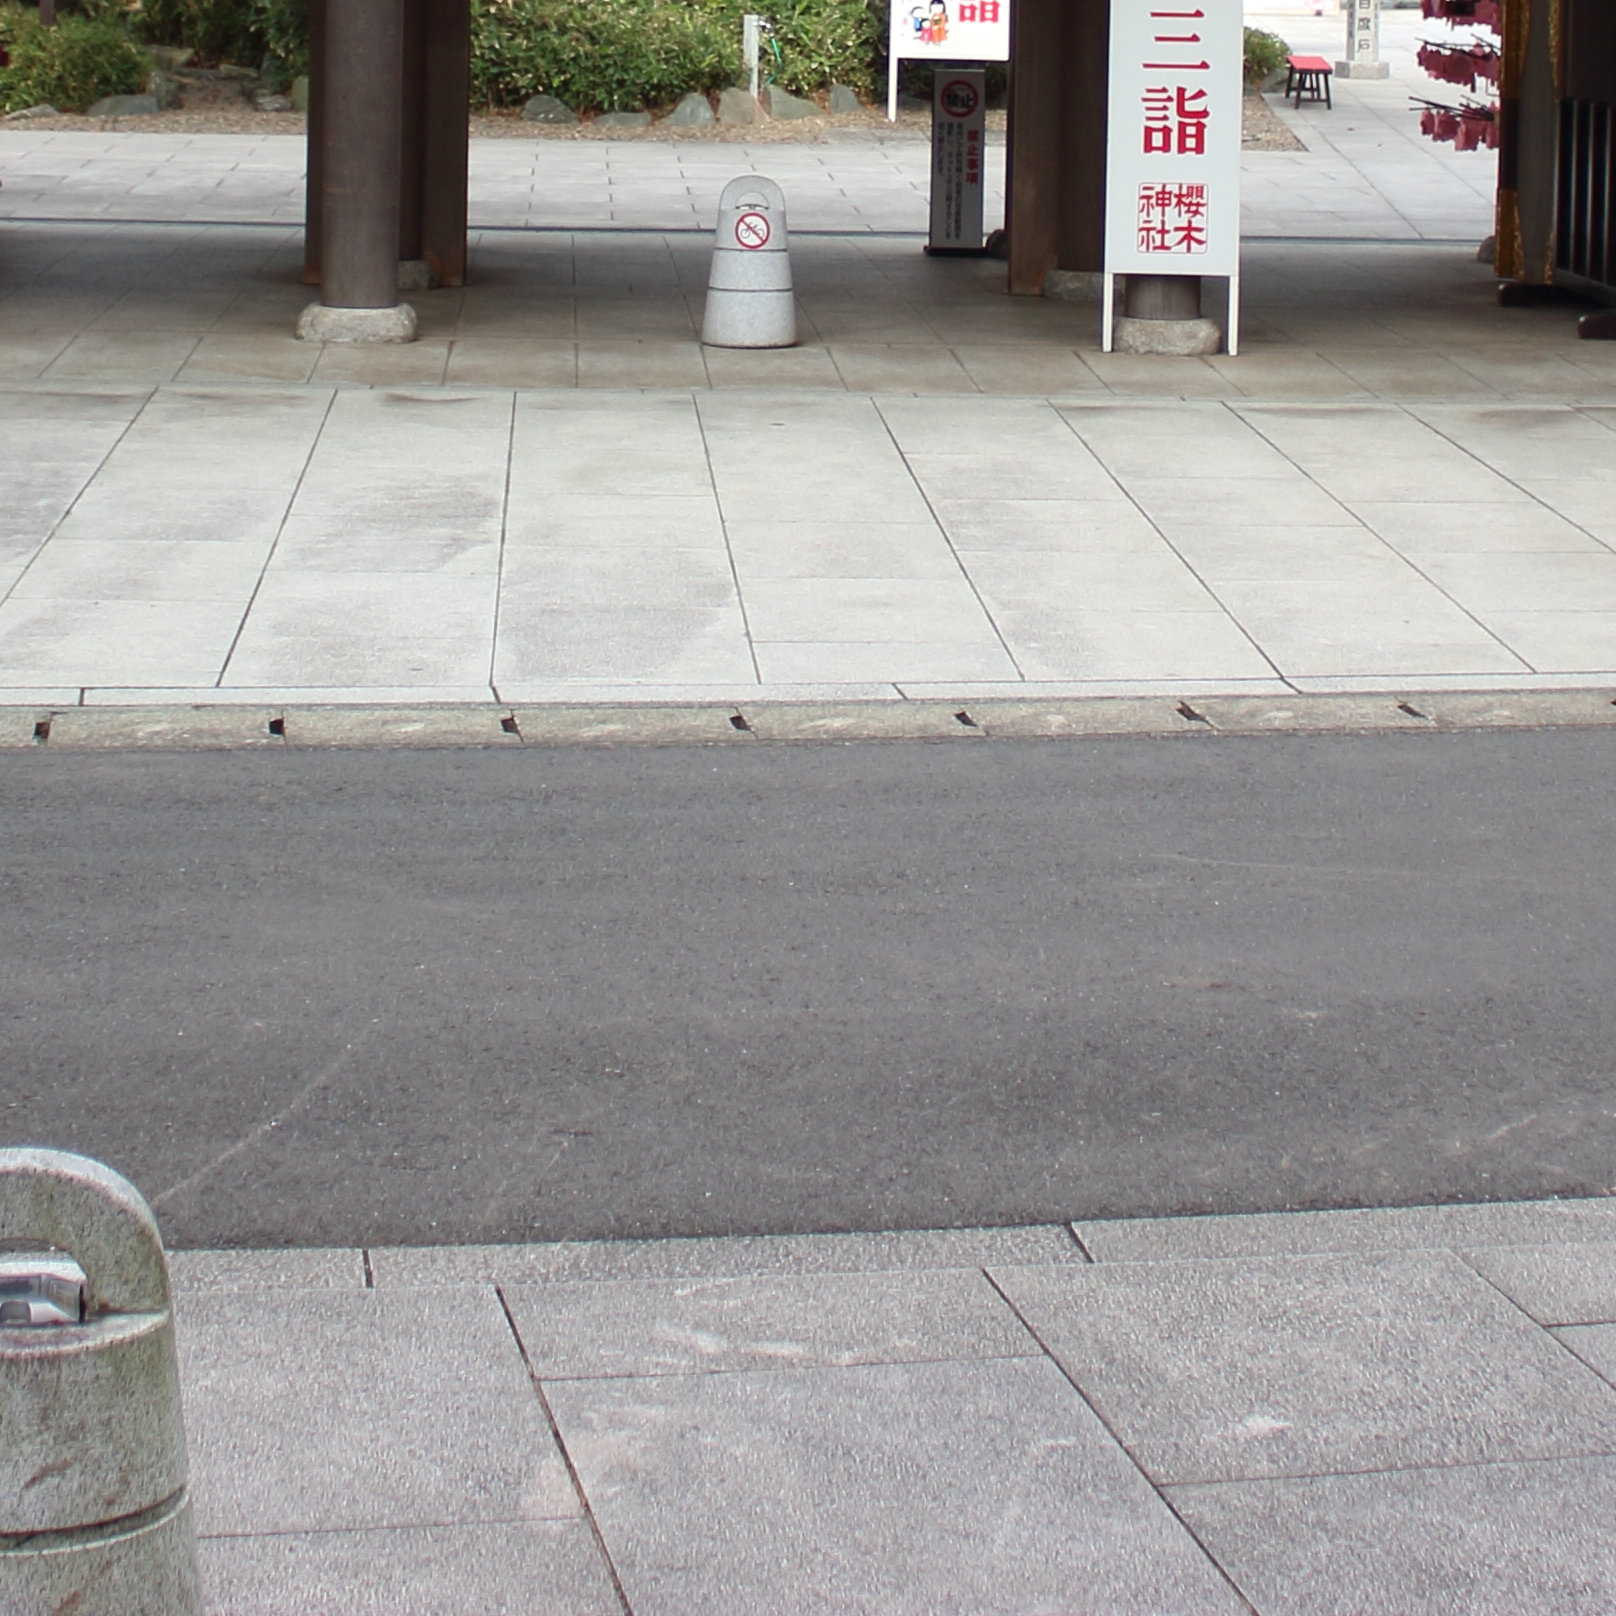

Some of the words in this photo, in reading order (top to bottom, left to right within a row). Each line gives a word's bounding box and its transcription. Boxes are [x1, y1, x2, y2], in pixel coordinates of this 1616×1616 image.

[946, 92, 975, 109] 禁止
[966, 129, 978, 186] 禁止事項
